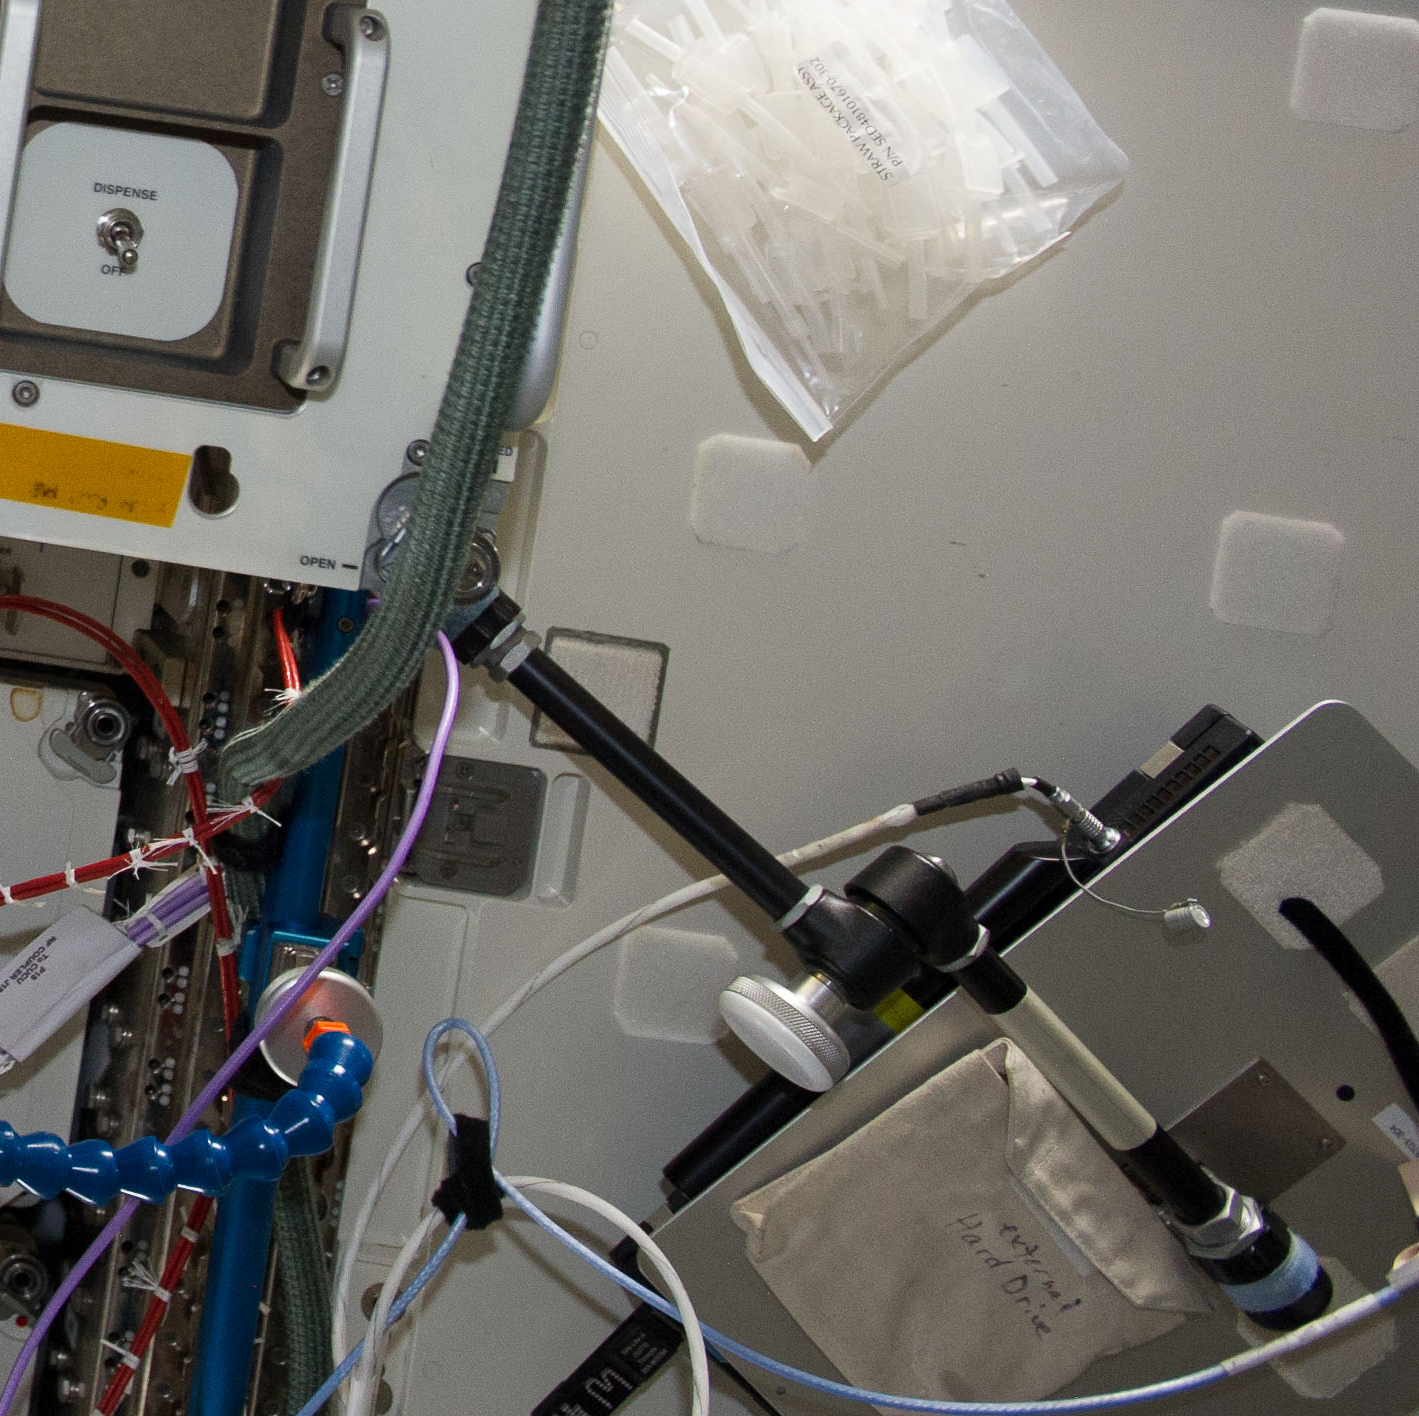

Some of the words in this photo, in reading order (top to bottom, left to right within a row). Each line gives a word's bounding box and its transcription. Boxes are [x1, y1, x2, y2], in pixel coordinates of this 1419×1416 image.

[816, 91, 861, 143] PACKAGE
[858, 142, 893, 181] STRAW
[885, 145, 903, 167] P/N
[92, 181, 160, 203] DISPENSE
[100, 263, 128, 277] OFF
[299, 555, 337, 571] OPEN
[9, 946, 46, 981] COUPLER
[16, 963, 39, 985] CUCU
[947, 1213, 1014, 1271] Hard
